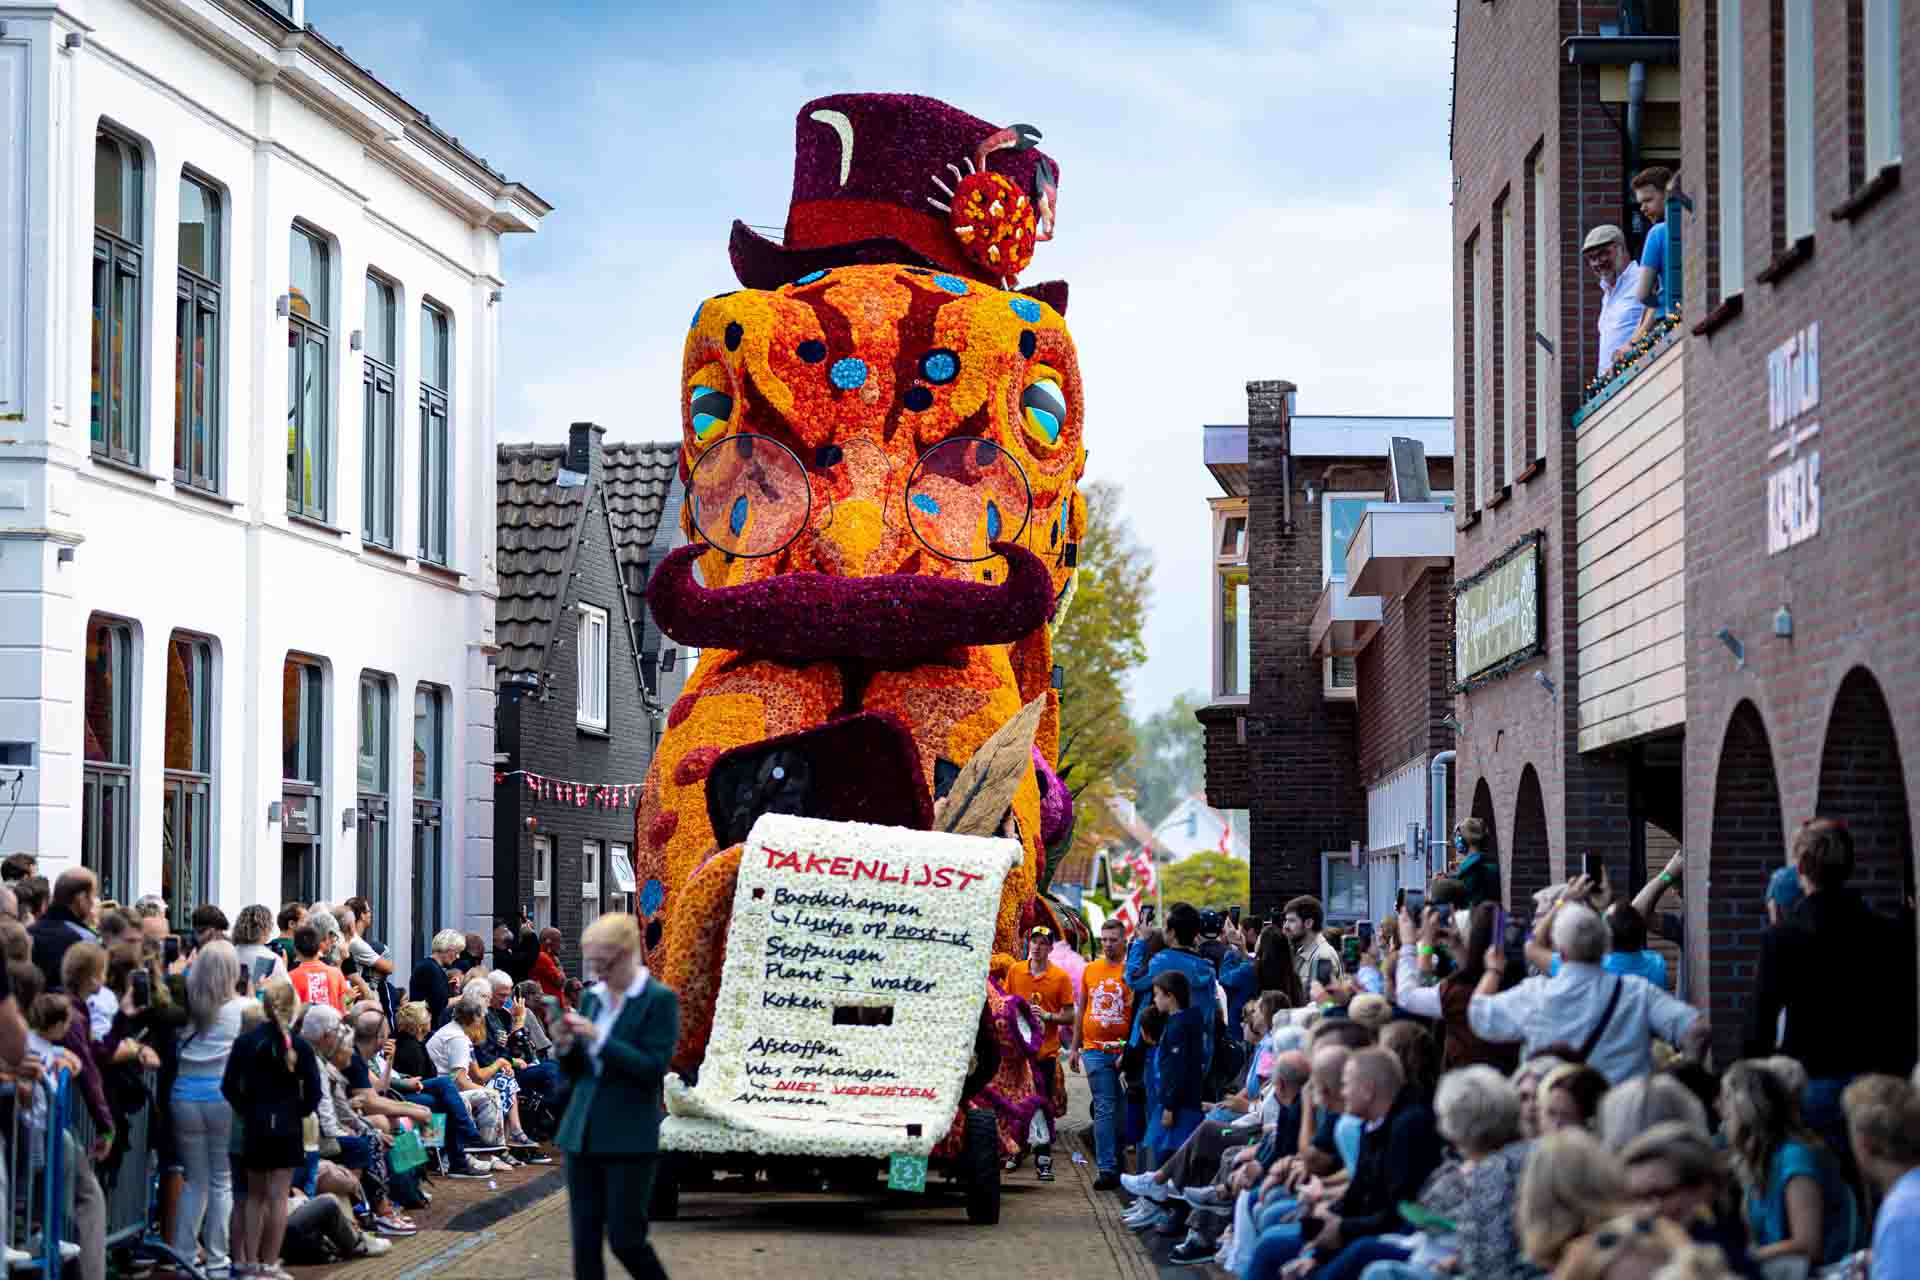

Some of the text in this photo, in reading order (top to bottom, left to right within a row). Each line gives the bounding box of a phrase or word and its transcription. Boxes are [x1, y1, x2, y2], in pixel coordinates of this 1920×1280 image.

[774, 887, 923, 917] Boodschappen
[862, 922, 888, 938] op
[892, 926, 972, 947] post-it
[765, 936, 885, 964] Stofzuigen
[765, 963, 938, 993] Plant water
[762, 991, 826, 1009] Koken
[747, 1036, 844, 1058] Afstoffen
[745, 1062, 899, 1081] Was ophangen
[773, 1080, 821, 1092] NIET
